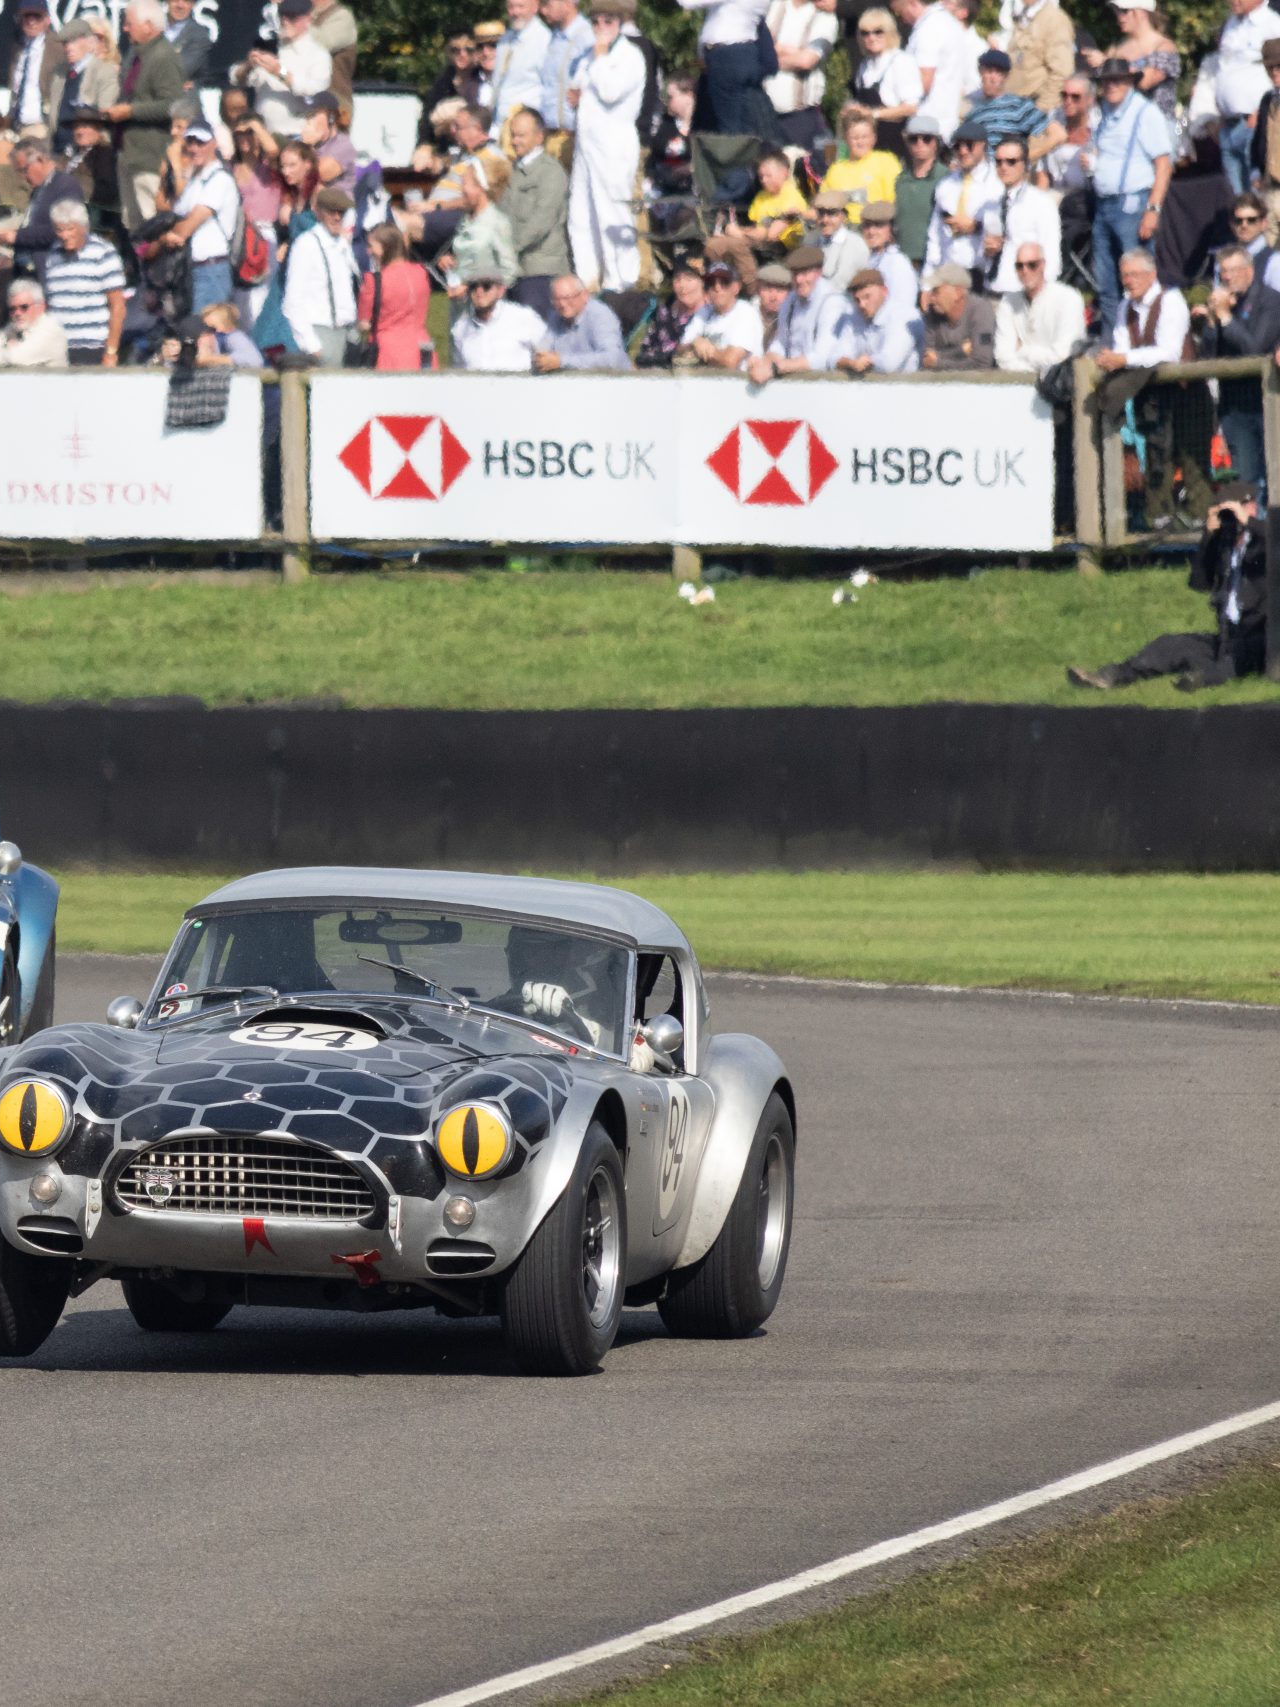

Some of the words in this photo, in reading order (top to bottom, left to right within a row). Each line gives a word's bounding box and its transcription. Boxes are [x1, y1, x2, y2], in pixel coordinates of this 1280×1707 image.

[484, 439, 594, 478] HSBC
[605, 440, 657, 481] UK
[851, 447, 963, 487] HSBC
[974, 448, 1026, 488] UK
[246, 1025, 356, 1048] 94
[662, 1096, 688, 1192] 94
